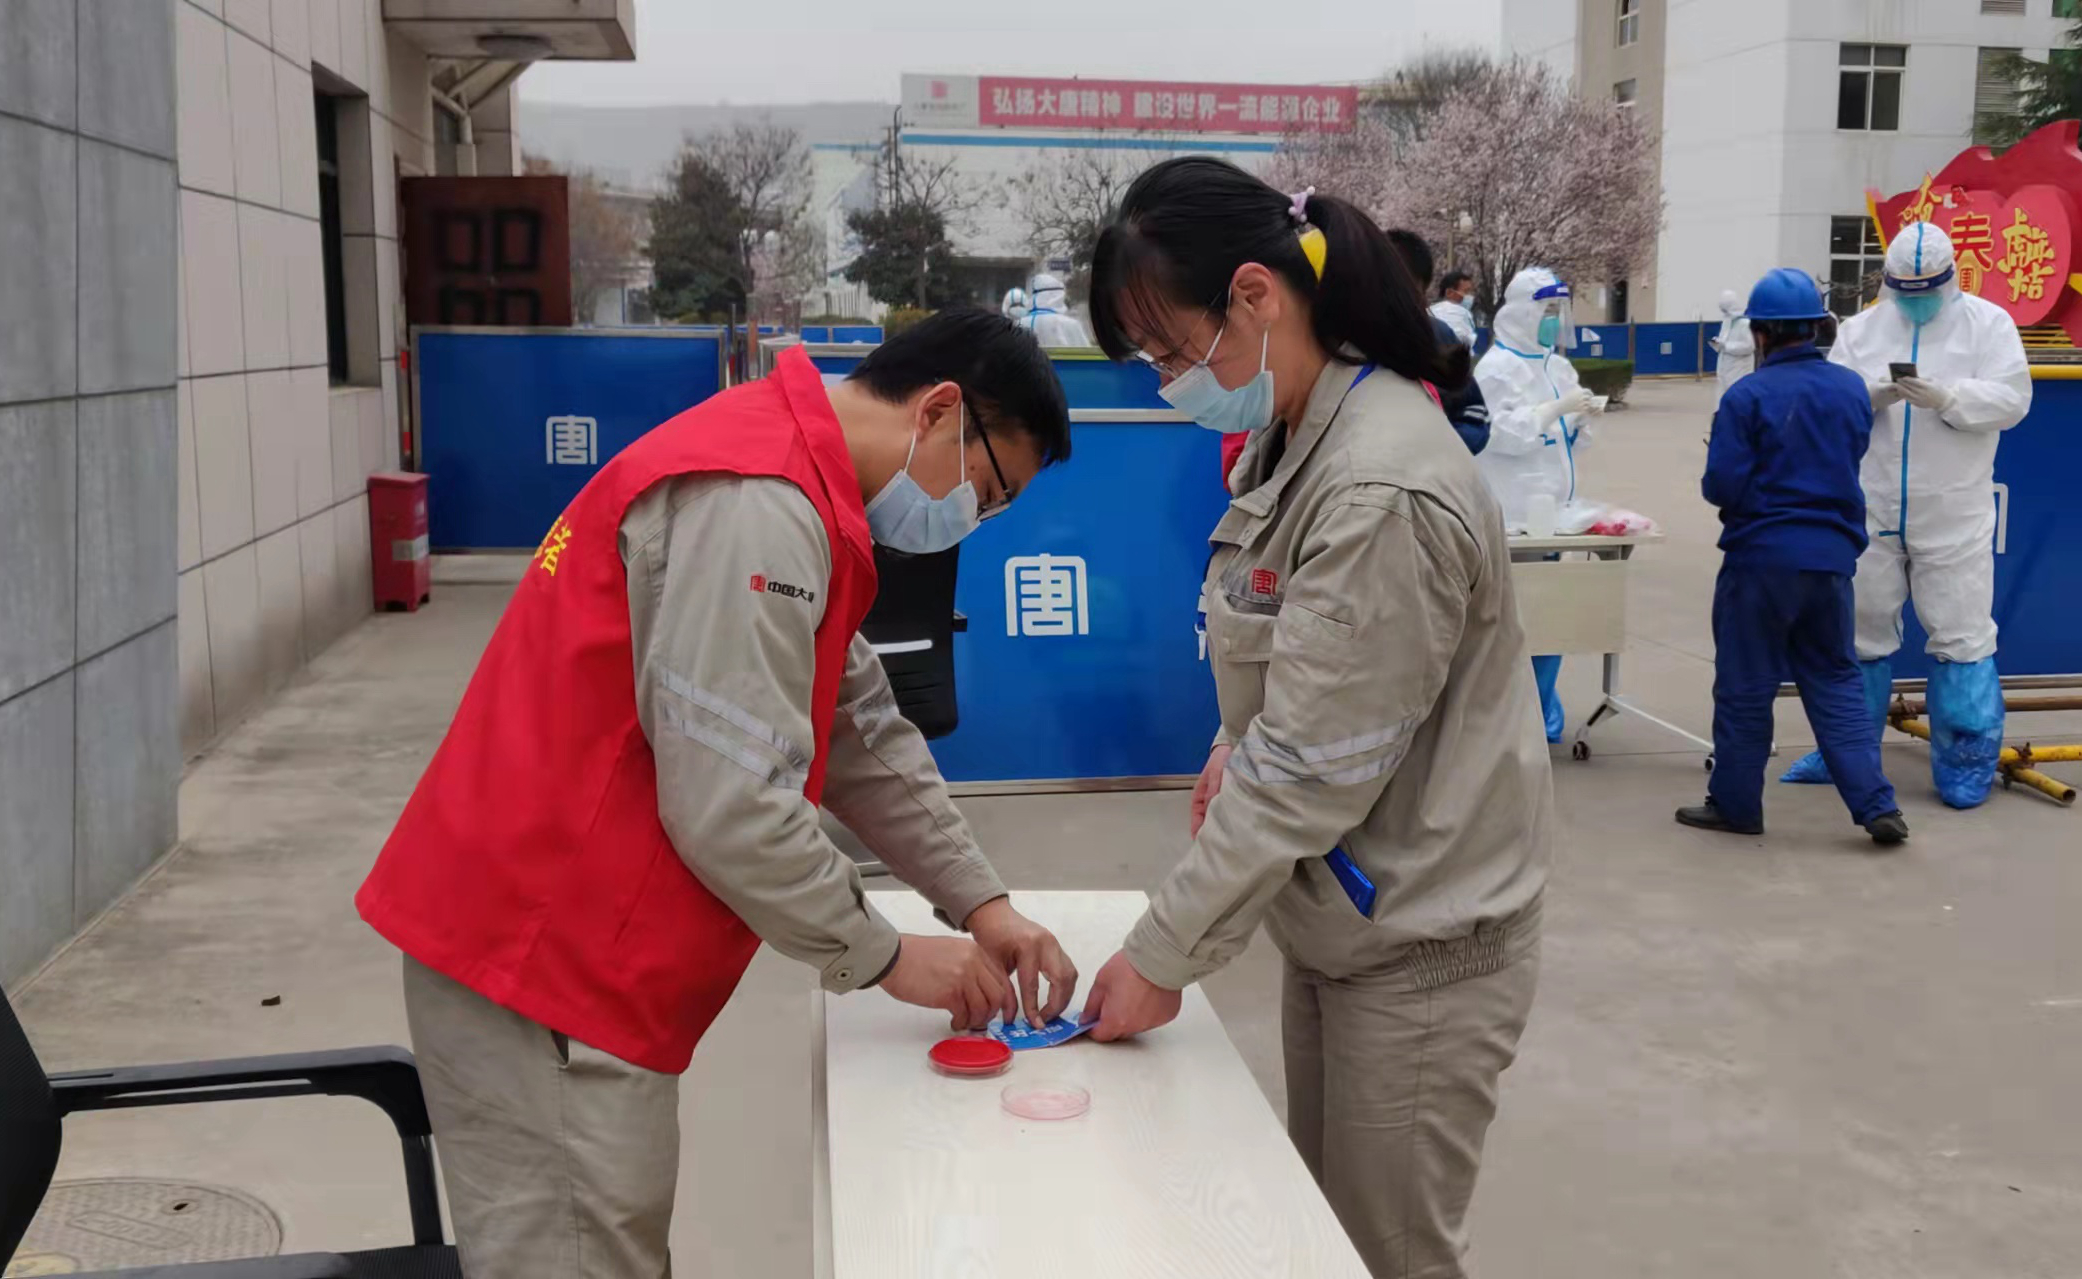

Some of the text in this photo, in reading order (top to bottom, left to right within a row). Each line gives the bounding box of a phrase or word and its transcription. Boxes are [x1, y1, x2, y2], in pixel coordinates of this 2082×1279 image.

[992, 87, 1122, 118] 弘扬大唐精神
